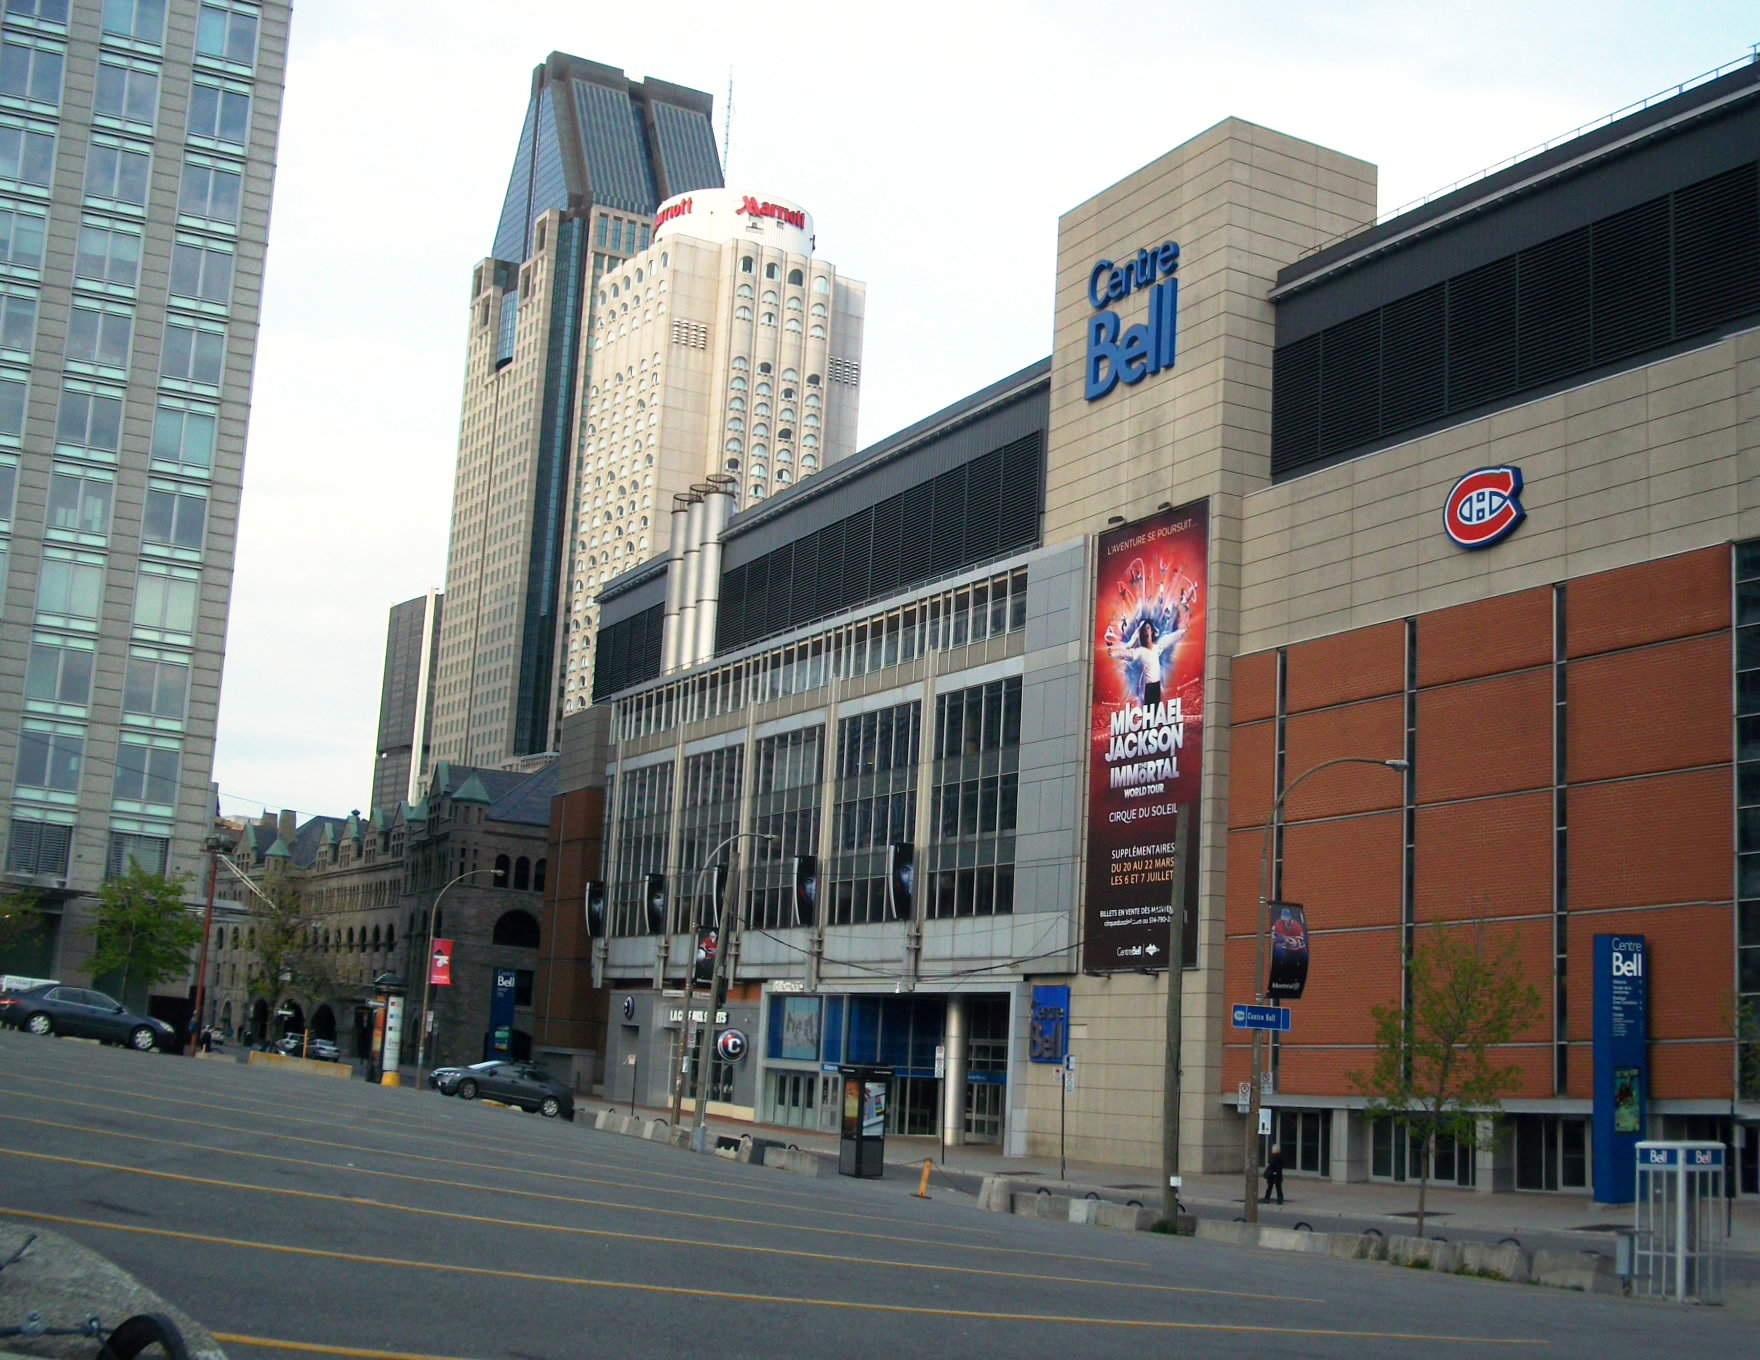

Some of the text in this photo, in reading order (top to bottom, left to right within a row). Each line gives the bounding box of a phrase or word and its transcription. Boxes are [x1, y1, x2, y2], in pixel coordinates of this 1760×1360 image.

[735, 195, 806, 230] Marriott
[1088, 240, 1180, 310] Centre
[1085, 277, 1178, 402] Bell
[1107, 534, 1146, 556] L'AVENTURE
[1147, 530, 1157, 543] SE
[1110, 697, 1184, 736] MICHAEL
[1105, 723, 1184, 762] JACKSON
[1110, 757, 1180, 789] IMMORTAL
[1124, 783, 1165, 799] WORLD TOUR
[1109, 802, 1179, 824] CIRQUE DU SOLEIL
[1111, 842, 1175, 860] SUPPLÉMENTAIRES
[1111, 856, 1175, 874] DU 20 AU 22 MARS
[1110, 870, 1174, 886] LES 6 ET 7 JUILLET
[1100, 909, 1118, 918] BILLETS
[1118, 908, 1125, 916] EN
[1125, 907, 1140, 915] VENTE
[1612, 937, 1642, 952] Centre
[1612, 952, 1642, 977] Bell
[497, 975, 515, 988] Bell
[1650, 1149, 1667, 1164] Bell
[1696, 1150, 1712, 1164] Bell
